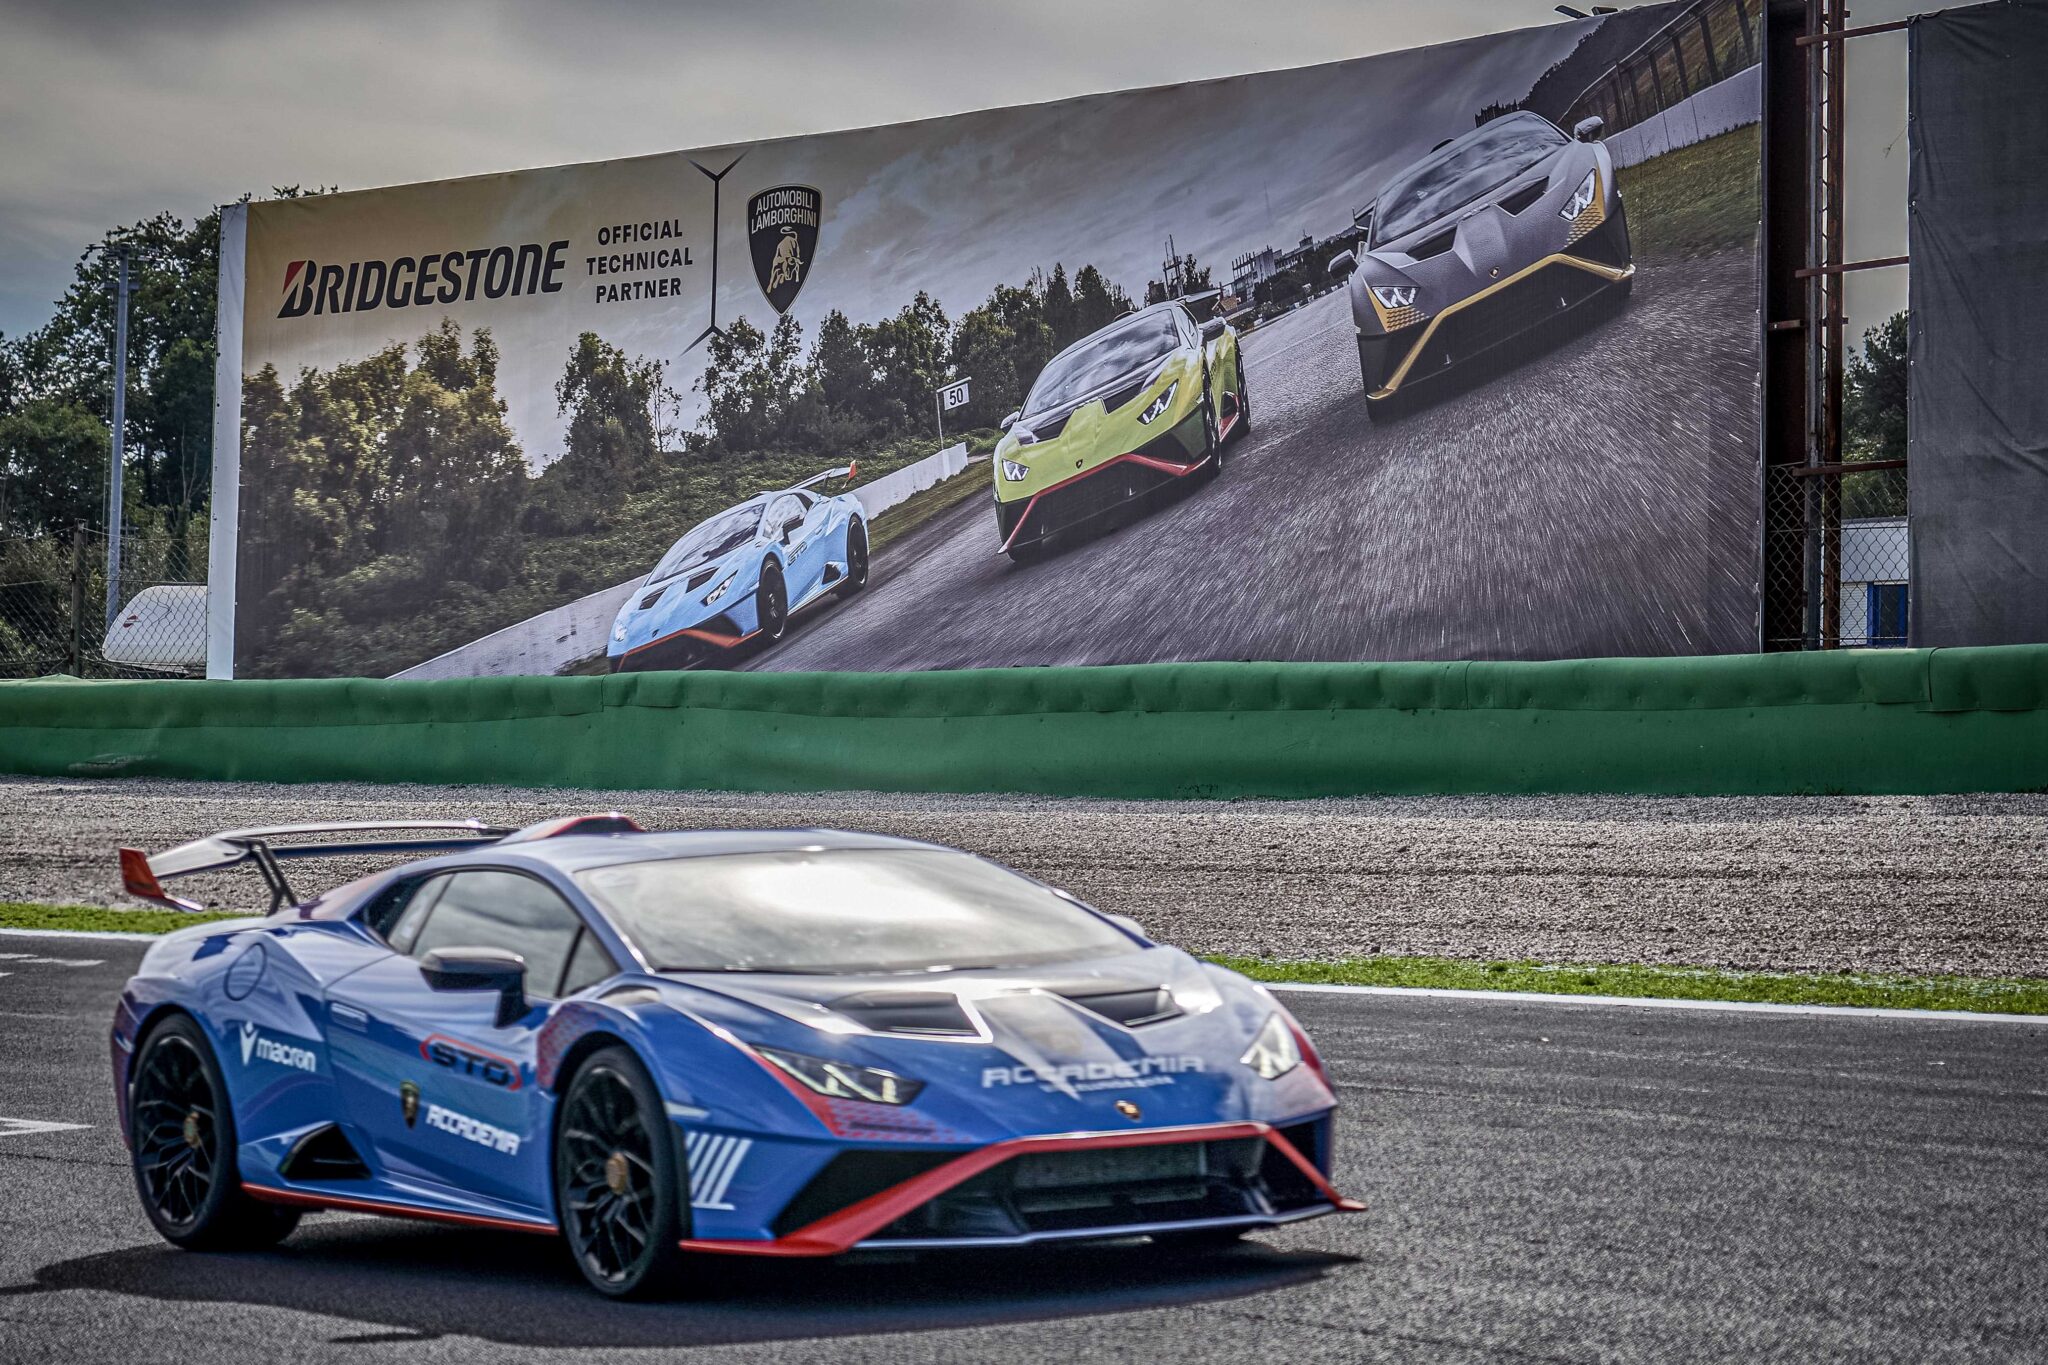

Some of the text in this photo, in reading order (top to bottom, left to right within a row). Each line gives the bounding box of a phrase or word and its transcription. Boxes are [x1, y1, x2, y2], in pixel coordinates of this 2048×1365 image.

[756, 190, 813, 215] AUTOMOBILI
[598, 219, 683, 246] OFFICIAL
[752, 208, 816, 235] LAMBORGHINI
[586, 247, 693, 276] TECHNICAL
[277, 240, 569, 319] BRIDGESTONE
[596, 278, 681, 304] PARTNER
[949, 387, 963, 406] 50
[256, 1038, 316, 1073] macron
[431, 1042, 511, 1086] STO
